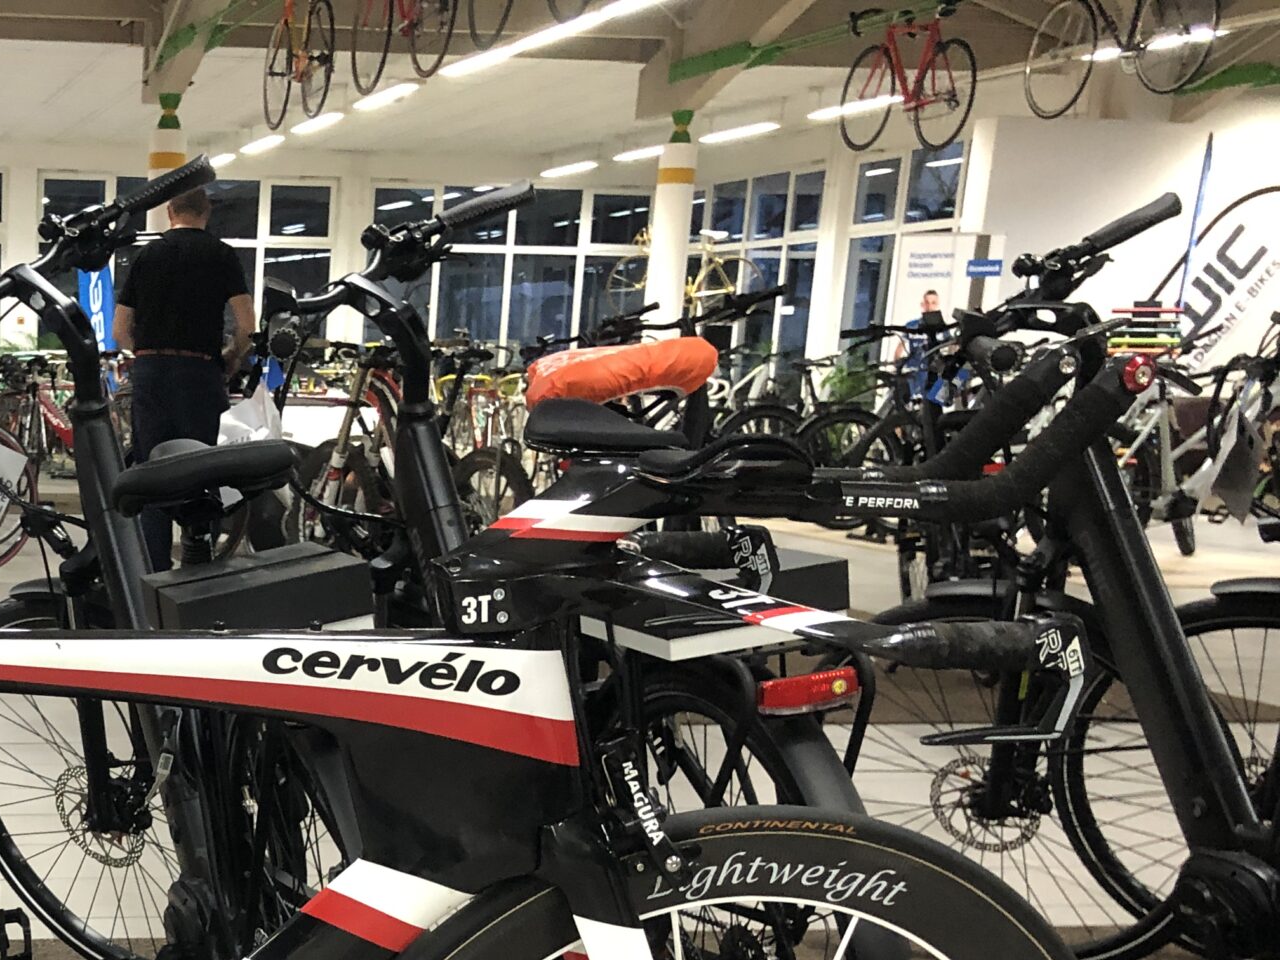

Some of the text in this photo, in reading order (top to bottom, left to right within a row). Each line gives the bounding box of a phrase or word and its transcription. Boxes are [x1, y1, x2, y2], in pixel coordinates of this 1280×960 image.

[461, 593, 491, 624] 3T
[1035, 628, 1067, 671] RT
[262, 647, 521, 697] cervélo
[622, 761, 665, 847] MAGURA
[699, 820, 858, 836] CONTINENTAL
